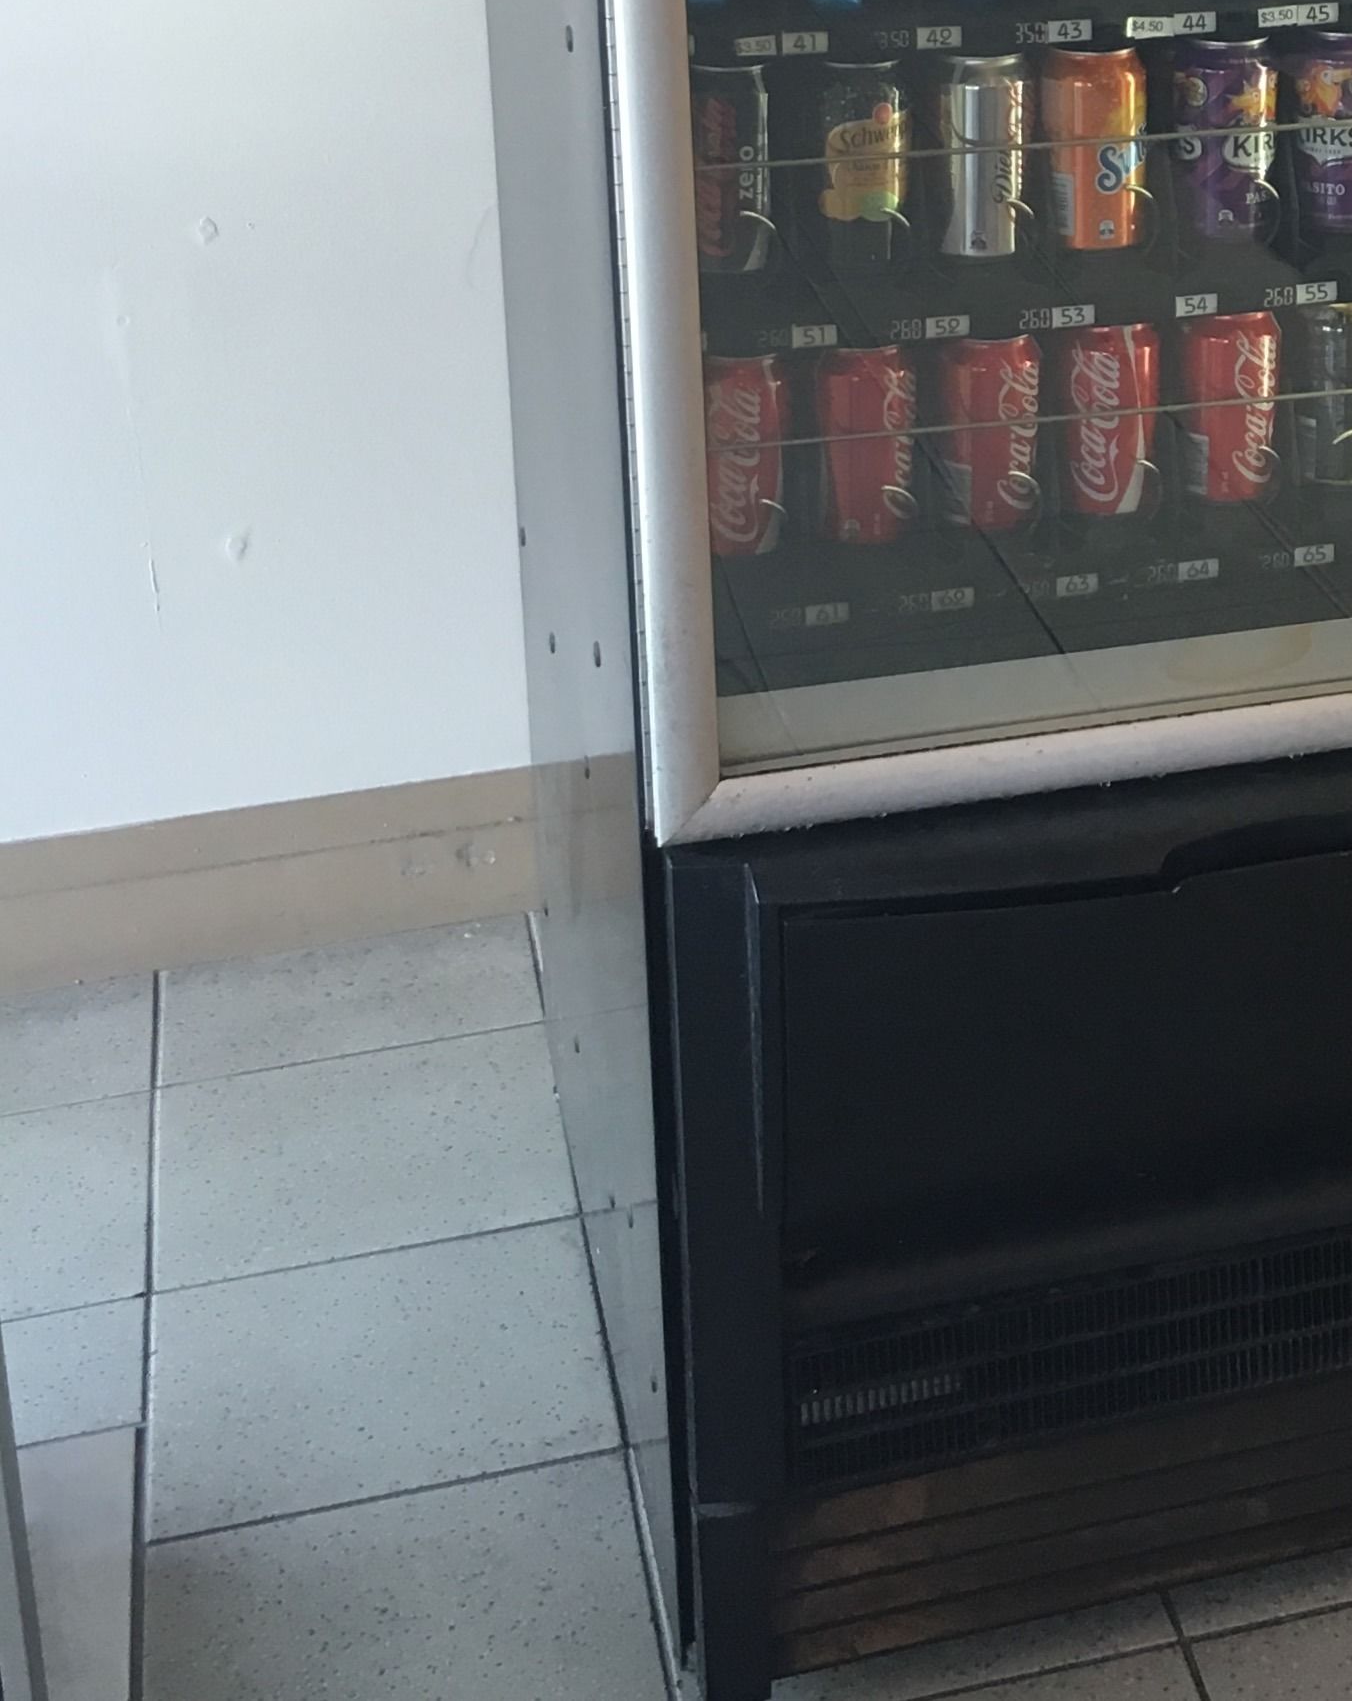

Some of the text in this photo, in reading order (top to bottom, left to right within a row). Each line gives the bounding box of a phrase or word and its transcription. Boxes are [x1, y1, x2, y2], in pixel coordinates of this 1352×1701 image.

[1260, 6, 1331, 24] $3.50 45
[1057, 23, 1083, 40] 43
[1131, 15, 1208, 33] $4.50 44
[792, 34, 818, 49] 41
[926, 29, 953, 45] 42
[1304, 284, 1329, 300] 55
[1184, 298, 1209, 314] 54
[1061, 307, 1086, 324] 53
[935, 317, 961, 334] 52
[802, 327, 825, 345] 51
[1070, 337, 1121, 502] Coca-Cola
[1303, 547, 1327, 563] 65
[1186, 561, 1210, 578] 64
[1064, 576, 1089, 592] 63
